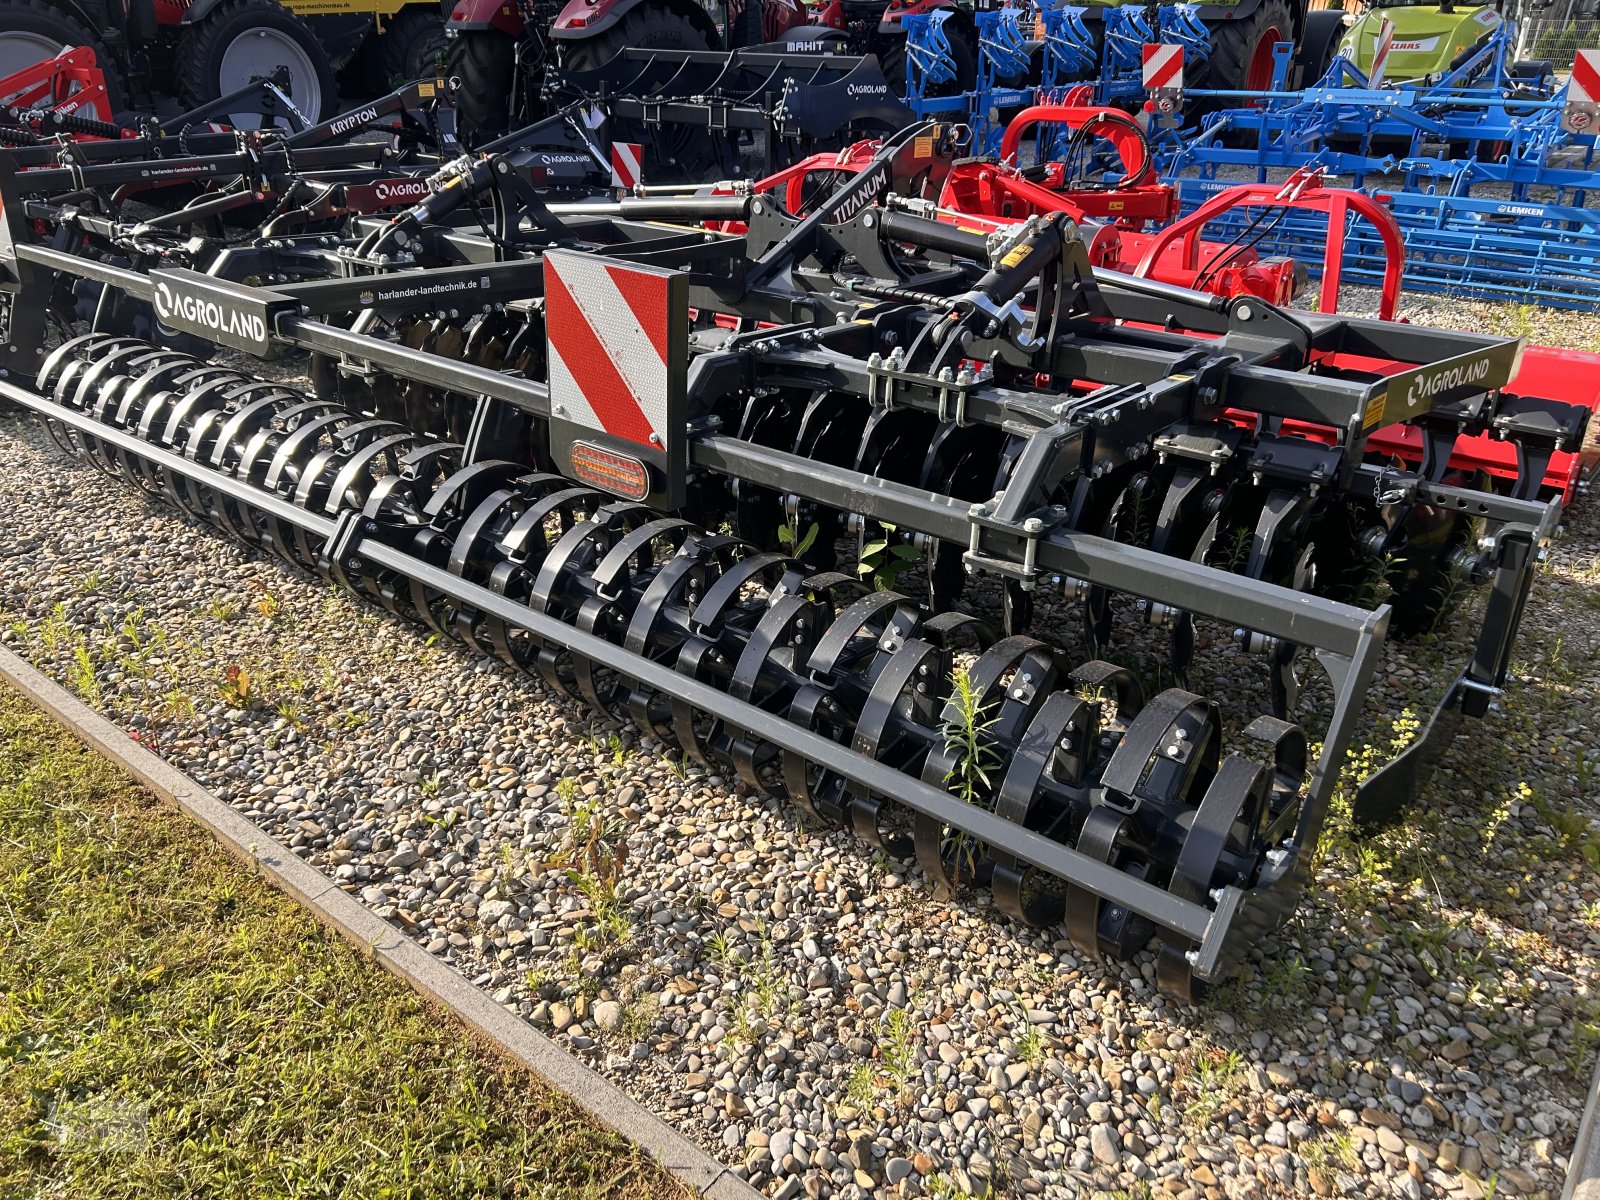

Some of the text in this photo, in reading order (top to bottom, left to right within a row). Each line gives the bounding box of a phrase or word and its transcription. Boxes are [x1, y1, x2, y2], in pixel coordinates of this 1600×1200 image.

[786, 40, 825, 52] MAHIT
[1341, 47, 1353, 59] 20
[854, 84, 887, 94] AGROLAND
[998, 95, 1021, 104] LEMKEN
[330, 107, 378, 135] KRYPTON
[551, 155, 591, 163] AGROLAND
[1207, 183, 1235, 192] LEMKE
[833, 168, 887, 225] TITANUM
[1506, 205, 1544, 216] LEMKEN
[378, 280, 478, 300] harlander-landtechnik.de
[173, 292, 266, 342] AGROLAND
[1421, 358, 1490, 398] AGROLAND
